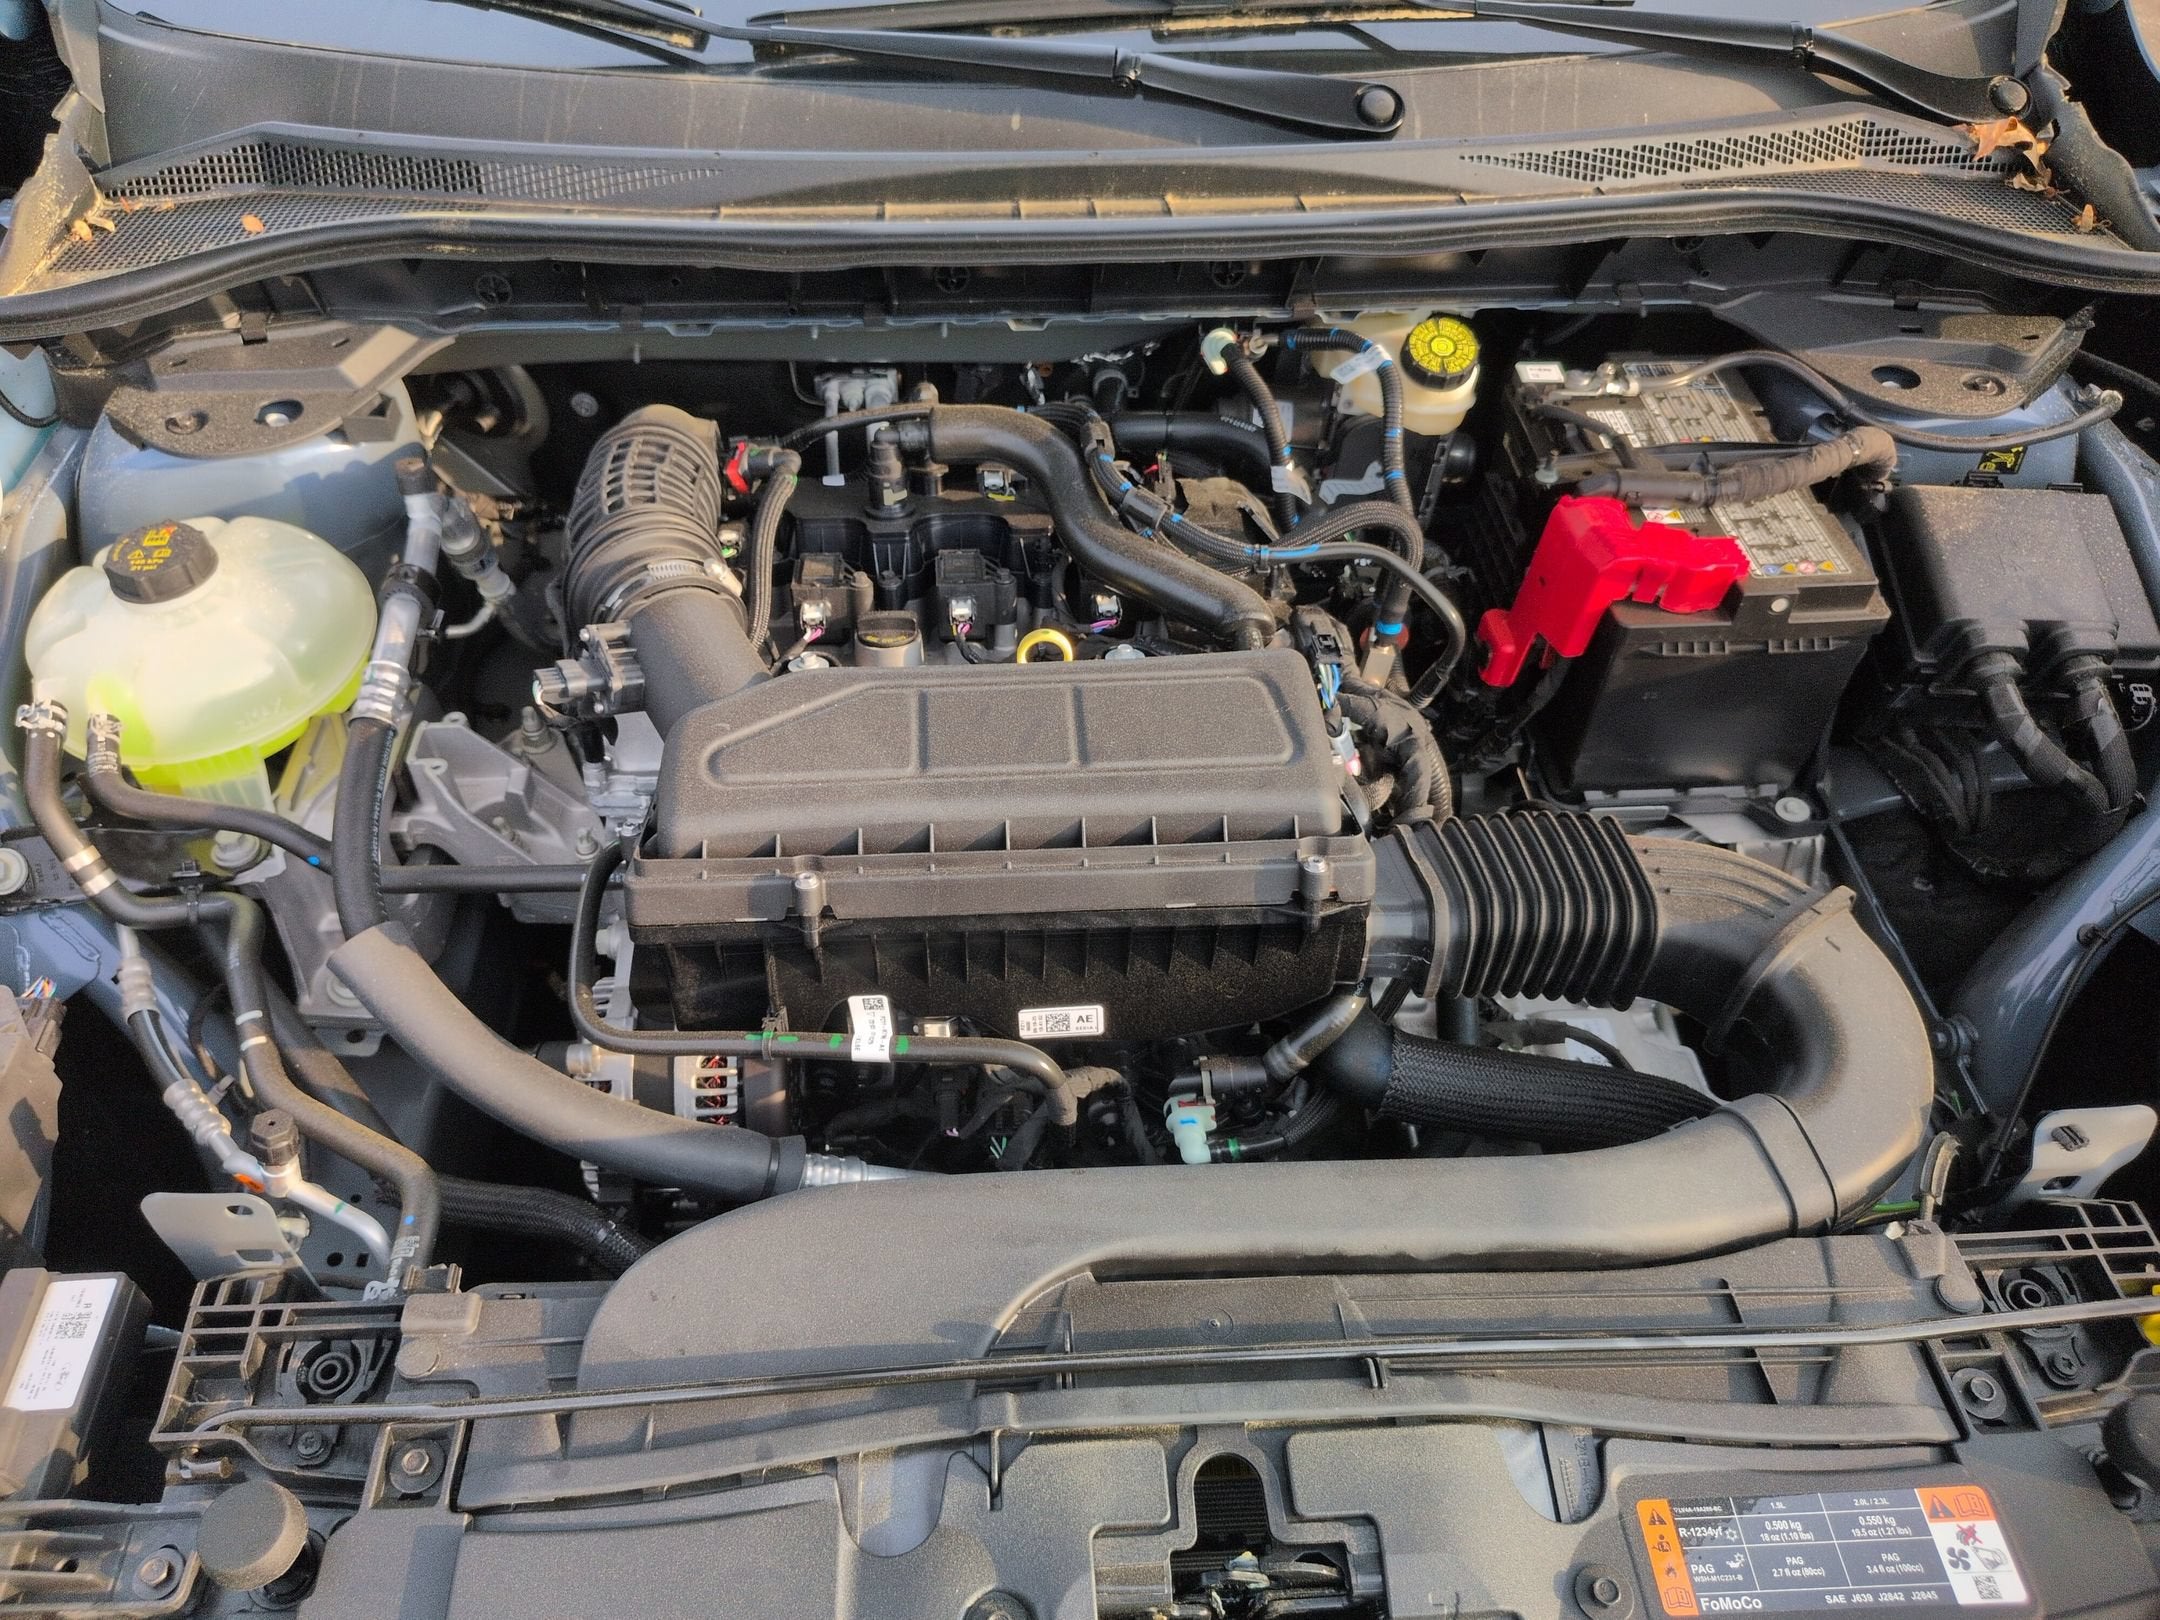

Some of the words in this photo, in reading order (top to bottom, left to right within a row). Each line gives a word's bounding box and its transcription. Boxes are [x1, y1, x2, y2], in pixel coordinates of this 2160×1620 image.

[1077, 1015, 1093, 1023] AE
[1765, 1521, 1789, 1531] 0.500
[1789, 1520, 1802, 1532] kg
[1858, 1516, 1882, 1526] 0.550
[1882, 1515, 1896, 1527] kg
[1678, 1526, 1722, 1538] R-1234yf
[1760, 1533, 1770, 1542] 18
[1780, 1532, 1799, 1542] (1.10
[1799, 1531, 1814, 1541] lbs)
[1851, 1528, 1867, 1537] 19.5
[1878, 1527, 1896, 1538] (1.21
[1896, 1526, 1912, 1536] lbs)
[1785, 1556, 1804, 1565] PAG
[1881, 1552, 1900, 1561] PAG
[1691, 1564, 1715, 1574] PAG
[1772, 1568, 1783, 1577] 2.7
[1784, 1567, 1791, 1576] fl
[1802, 1567, 1825, 1577] (80cc)
[1866, 1565, 1879, 1574] 3.4
[1879, 1564, 1886, 1573] fl
[1886, 1565, 1896, 1573] oz
[1896, 1563, 1924, 1575] (100cc)
[1700, 1596, 1762, 1611] FoMoCo
[1824, 1594, 1847, 1604] SAE
